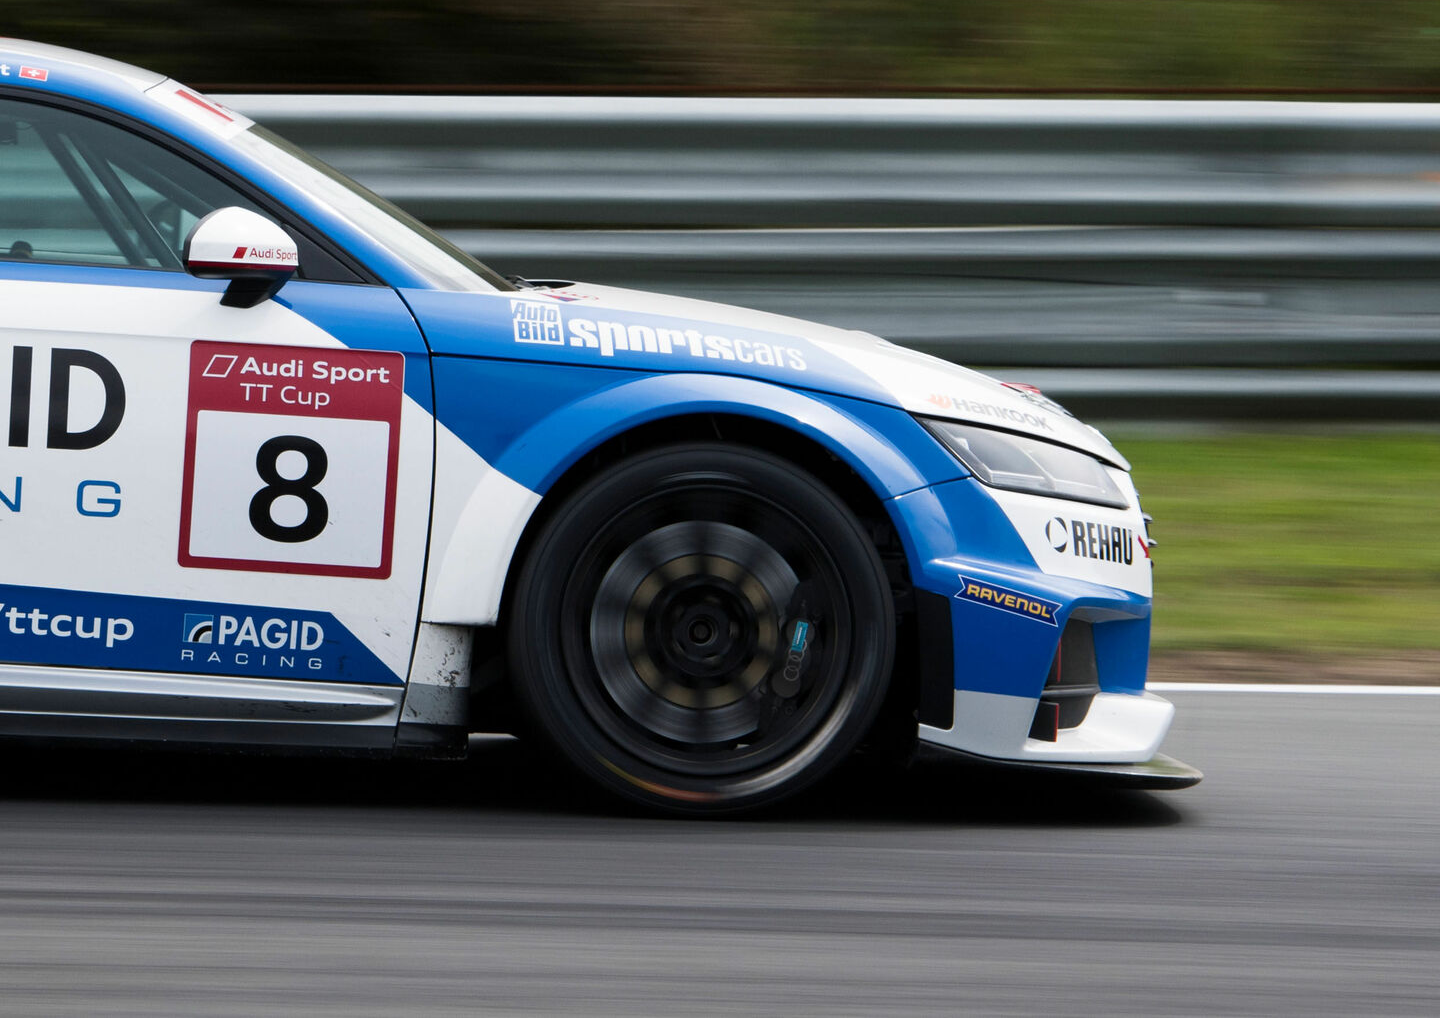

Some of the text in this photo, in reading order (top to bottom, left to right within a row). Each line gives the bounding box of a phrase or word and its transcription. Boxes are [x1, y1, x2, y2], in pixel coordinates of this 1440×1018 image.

[249, 247, 297, 262] Audi Sport
[513, 301, 558, 323] Auto
[517, 320, 561, 342] Bild
[240, 356, 390, 385] Audi Sport
[240, 382, 331, 410] TT Cup
[248, 434, 329, 544] 8
[1071, 520, 1133, 566] REHAU
[966, 583, 1051, 619] RAVENOL
[218, 615, 324, 651] PAGID
[181, 649, 323, 670] RACING
